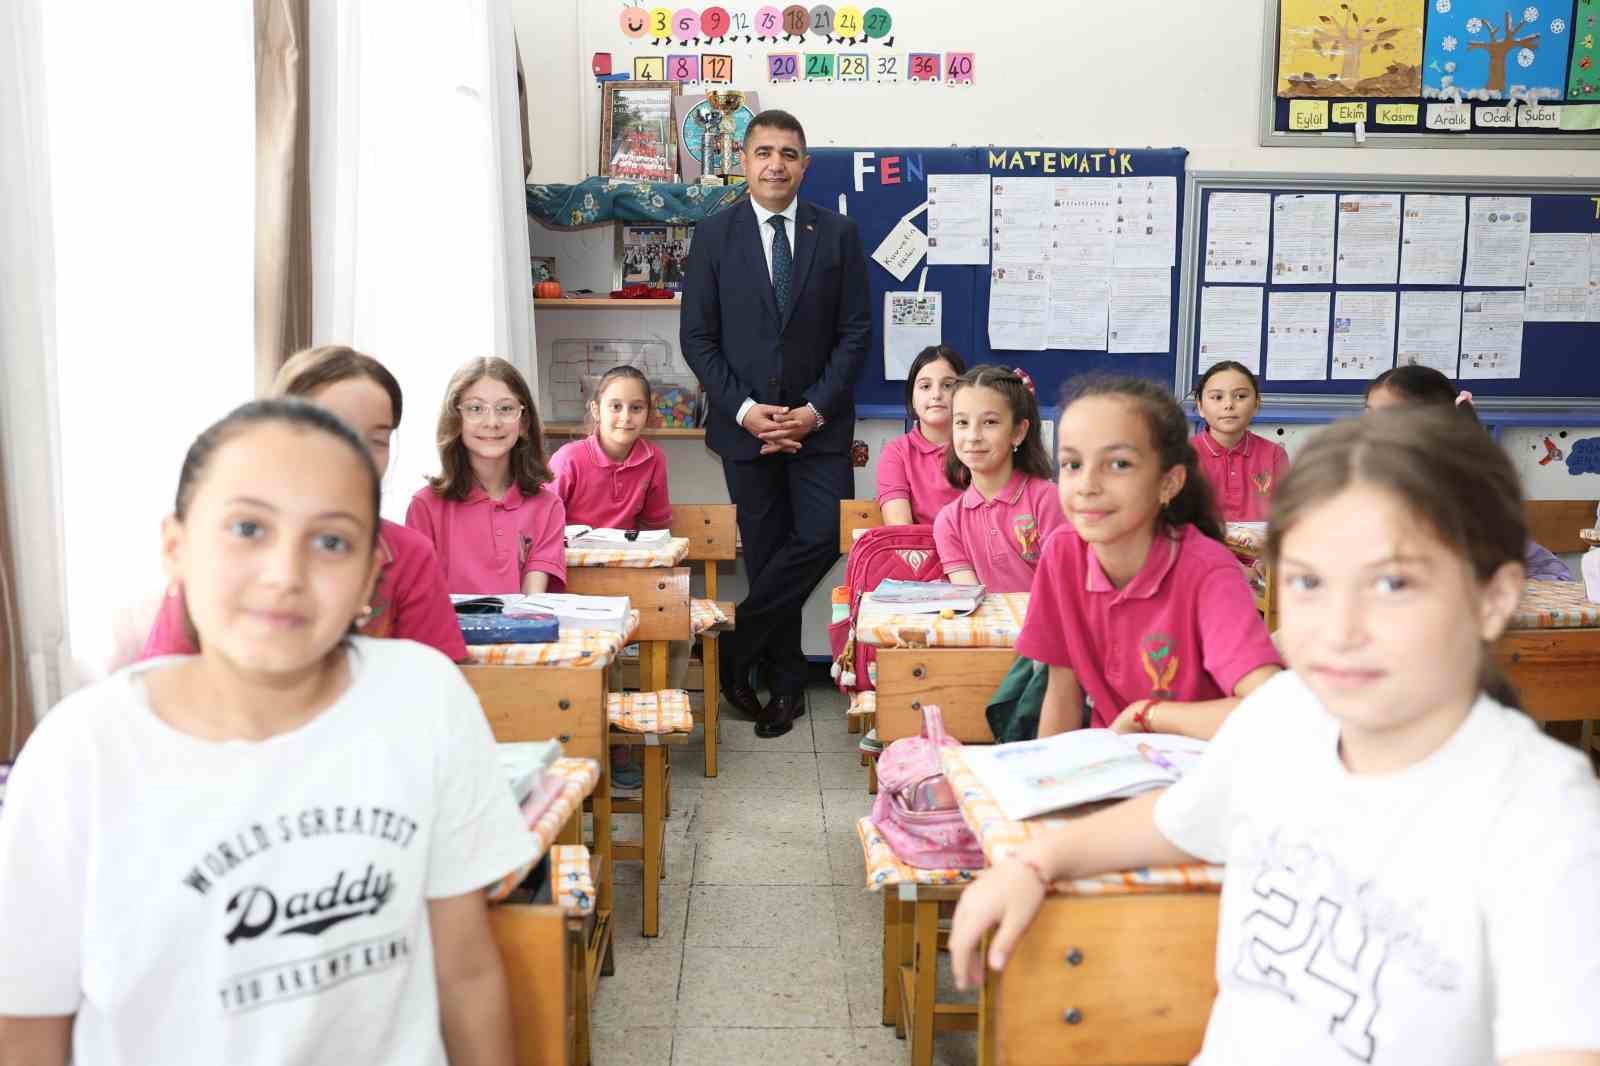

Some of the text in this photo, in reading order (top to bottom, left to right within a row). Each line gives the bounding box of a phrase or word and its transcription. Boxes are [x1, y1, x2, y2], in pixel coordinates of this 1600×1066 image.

[656, 12, 666, 31] 3
[679, 18, 694, 31] 6
[711, 12, 720, 30] 9
[732, 12, 750, 31] 12
[787, 11, 805, 30] 18
[814, 12, 831, 28] 21
[840, 14, 856, 31] 24
[867, 15, 887, 31] 27
[641, 56, 972, 80] 4 8 12 20 24 28 32 36 40
[1340, 106, 1365, 119] Ekim
[1482, 111, 1512, 123] Ocak
[853, 152, 923, 191] FEN
[298, 806, 418, 848] GREATEST
[225, 863, 397, 945] Daddy
